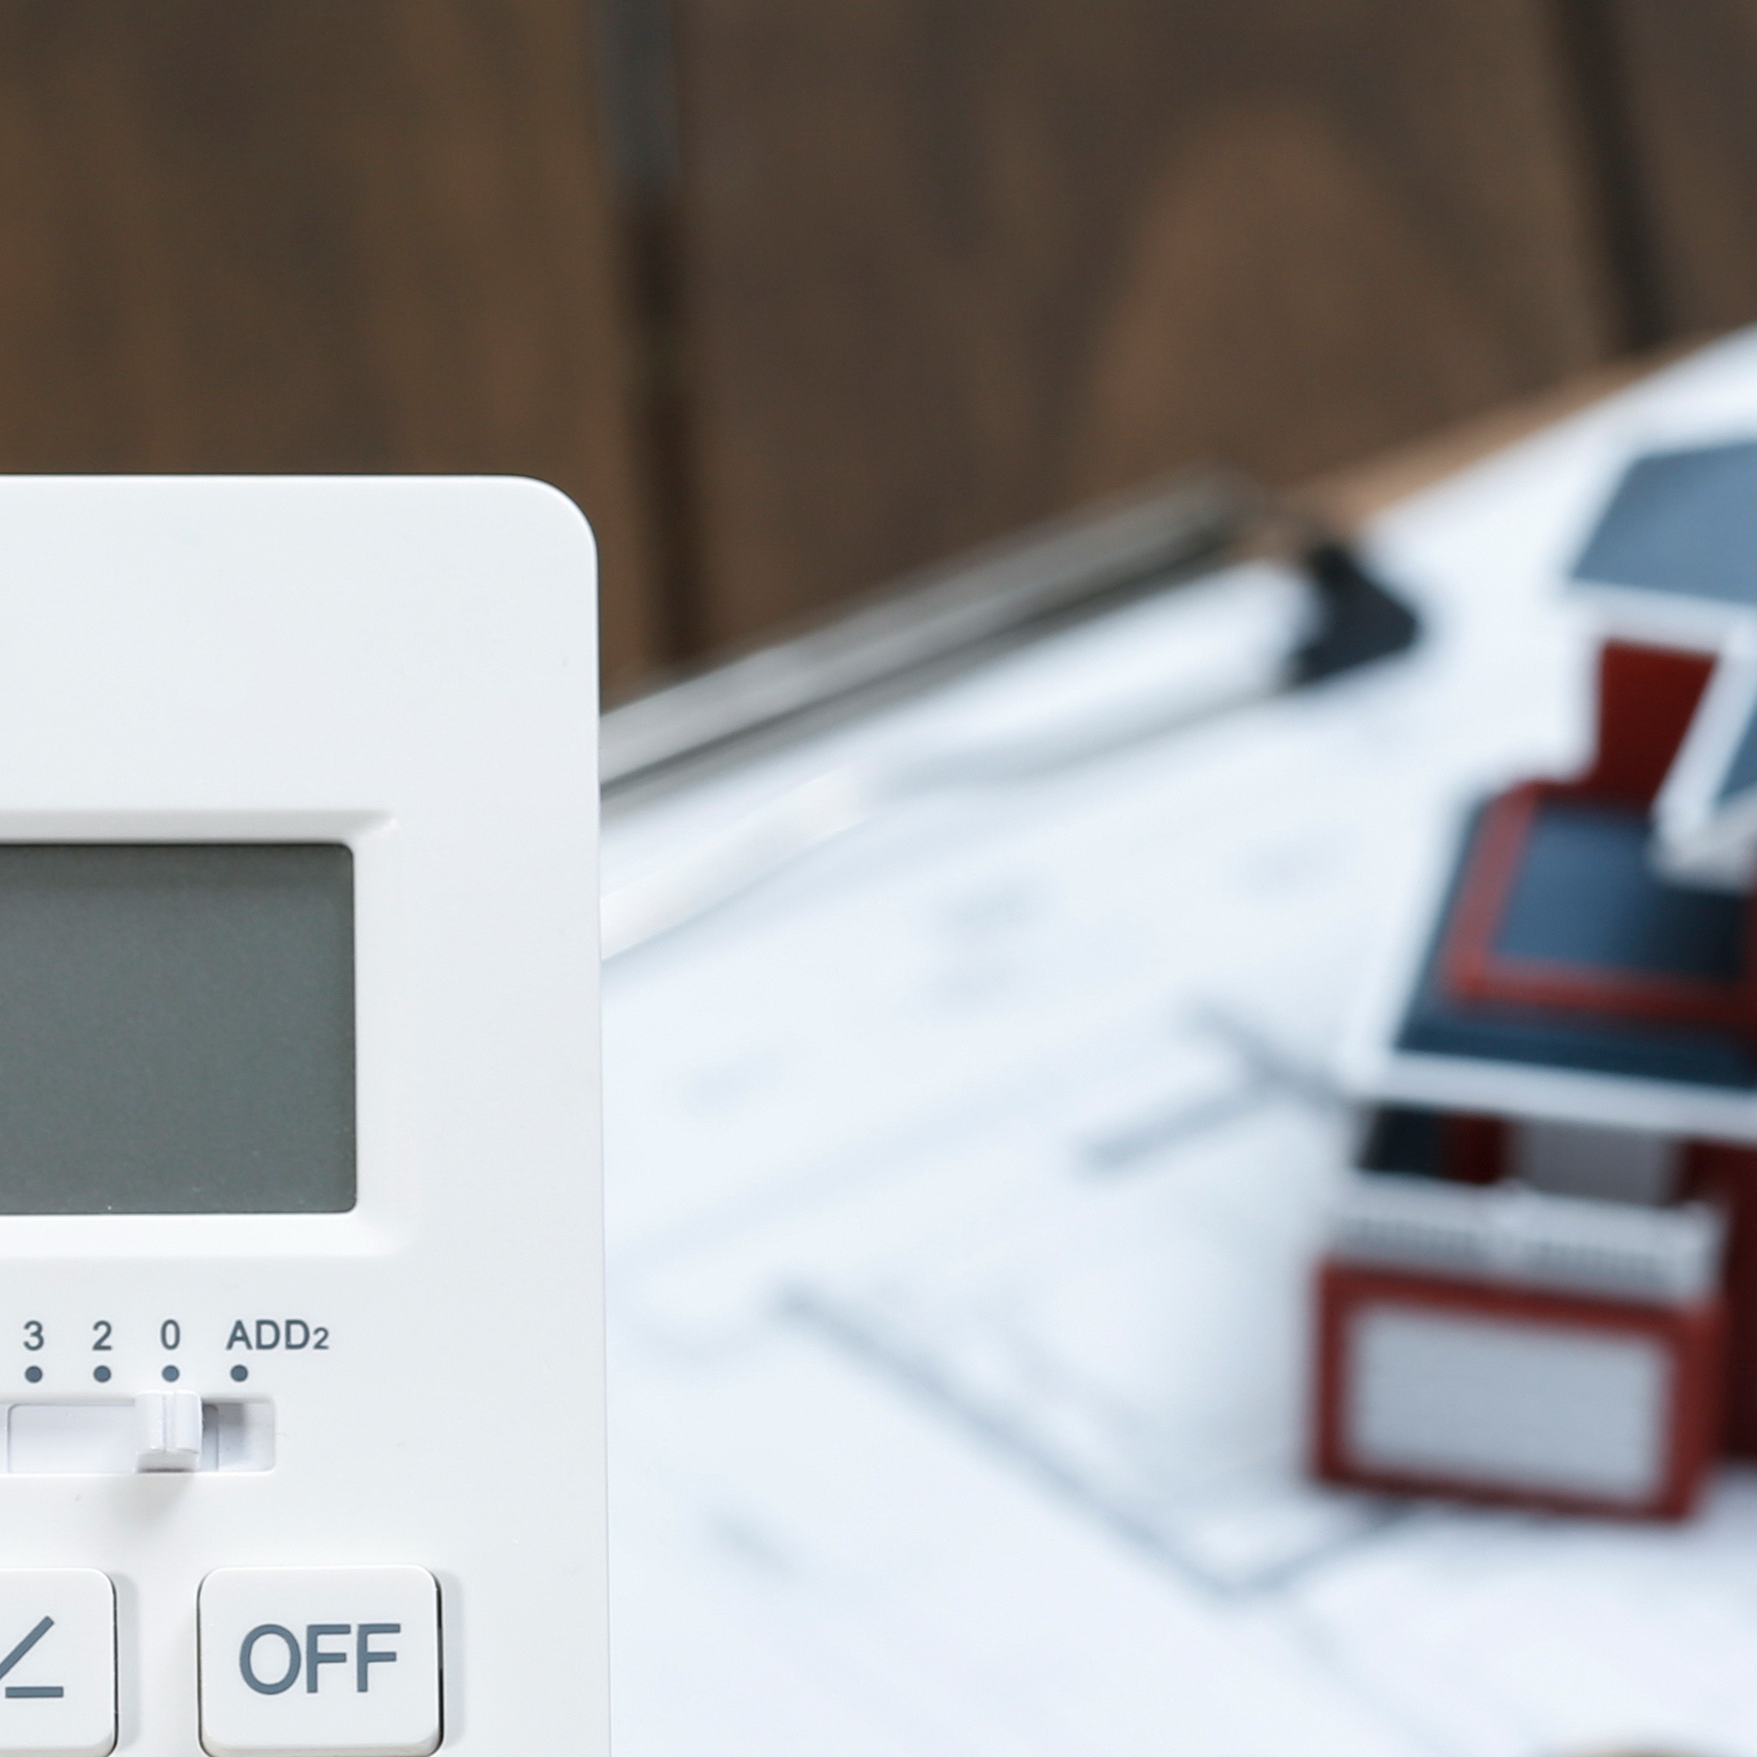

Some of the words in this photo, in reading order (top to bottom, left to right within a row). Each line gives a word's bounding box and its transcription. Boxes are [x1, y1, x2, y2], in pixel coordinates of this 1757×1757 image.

[23, 1320, 45, 1352] 3
[92, 1320, 112, 1351] 2
[160, 1318, 181, 1351] 0
[239, 1622, 402, 1696] OFF
